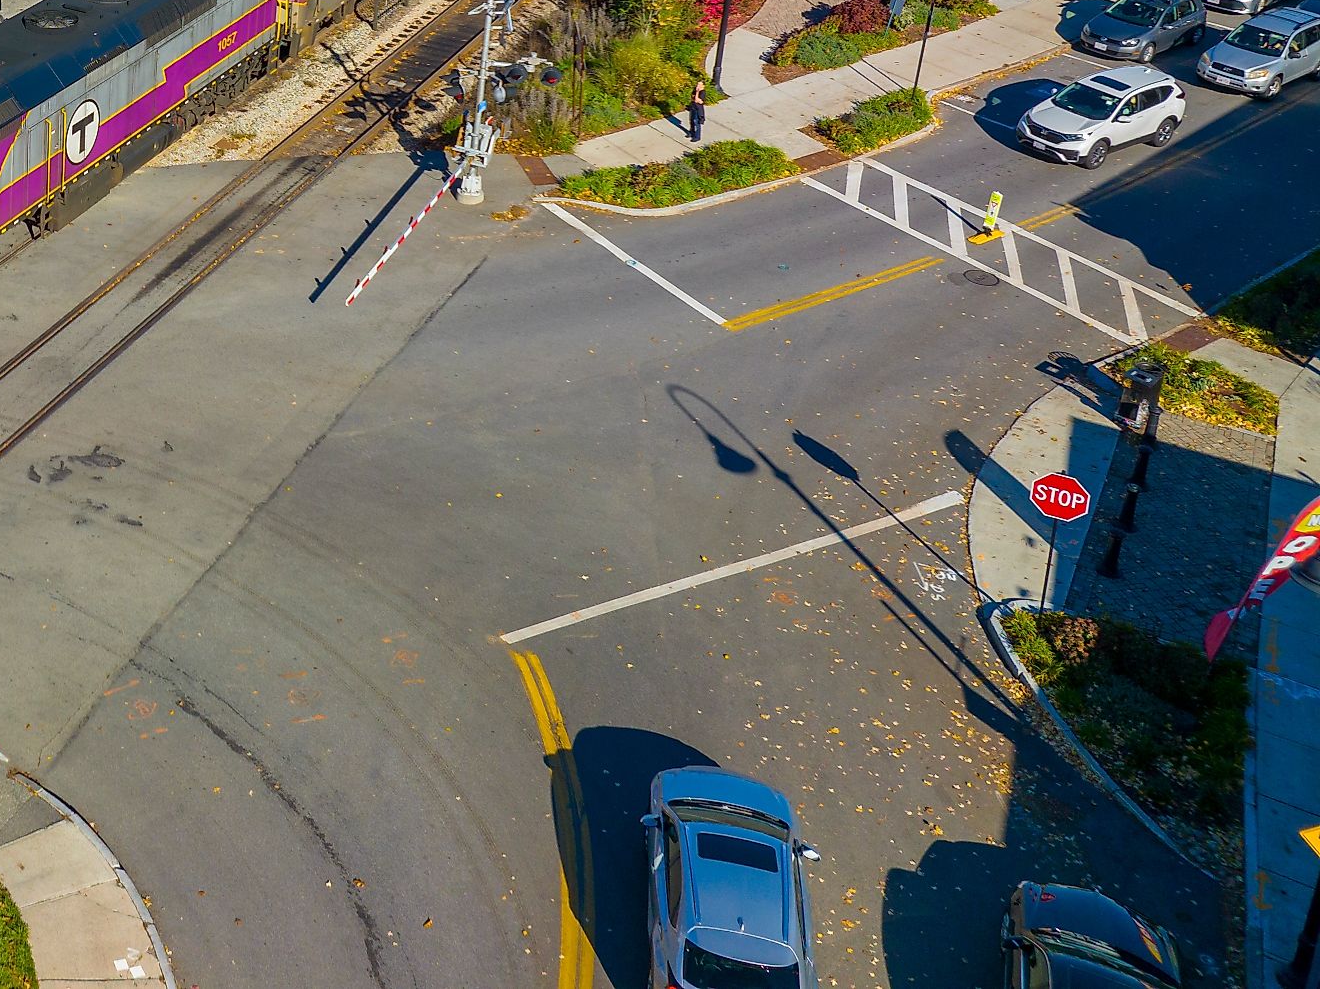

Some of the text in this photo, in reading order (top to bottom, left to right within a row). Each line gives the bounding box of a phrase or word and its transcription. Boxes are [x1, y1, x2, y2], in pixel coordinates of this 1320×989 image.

[217, 31, 238, 52] 1057
[71, 111, 95, 155] T
[1034, 484, 1086, 509] STOP
